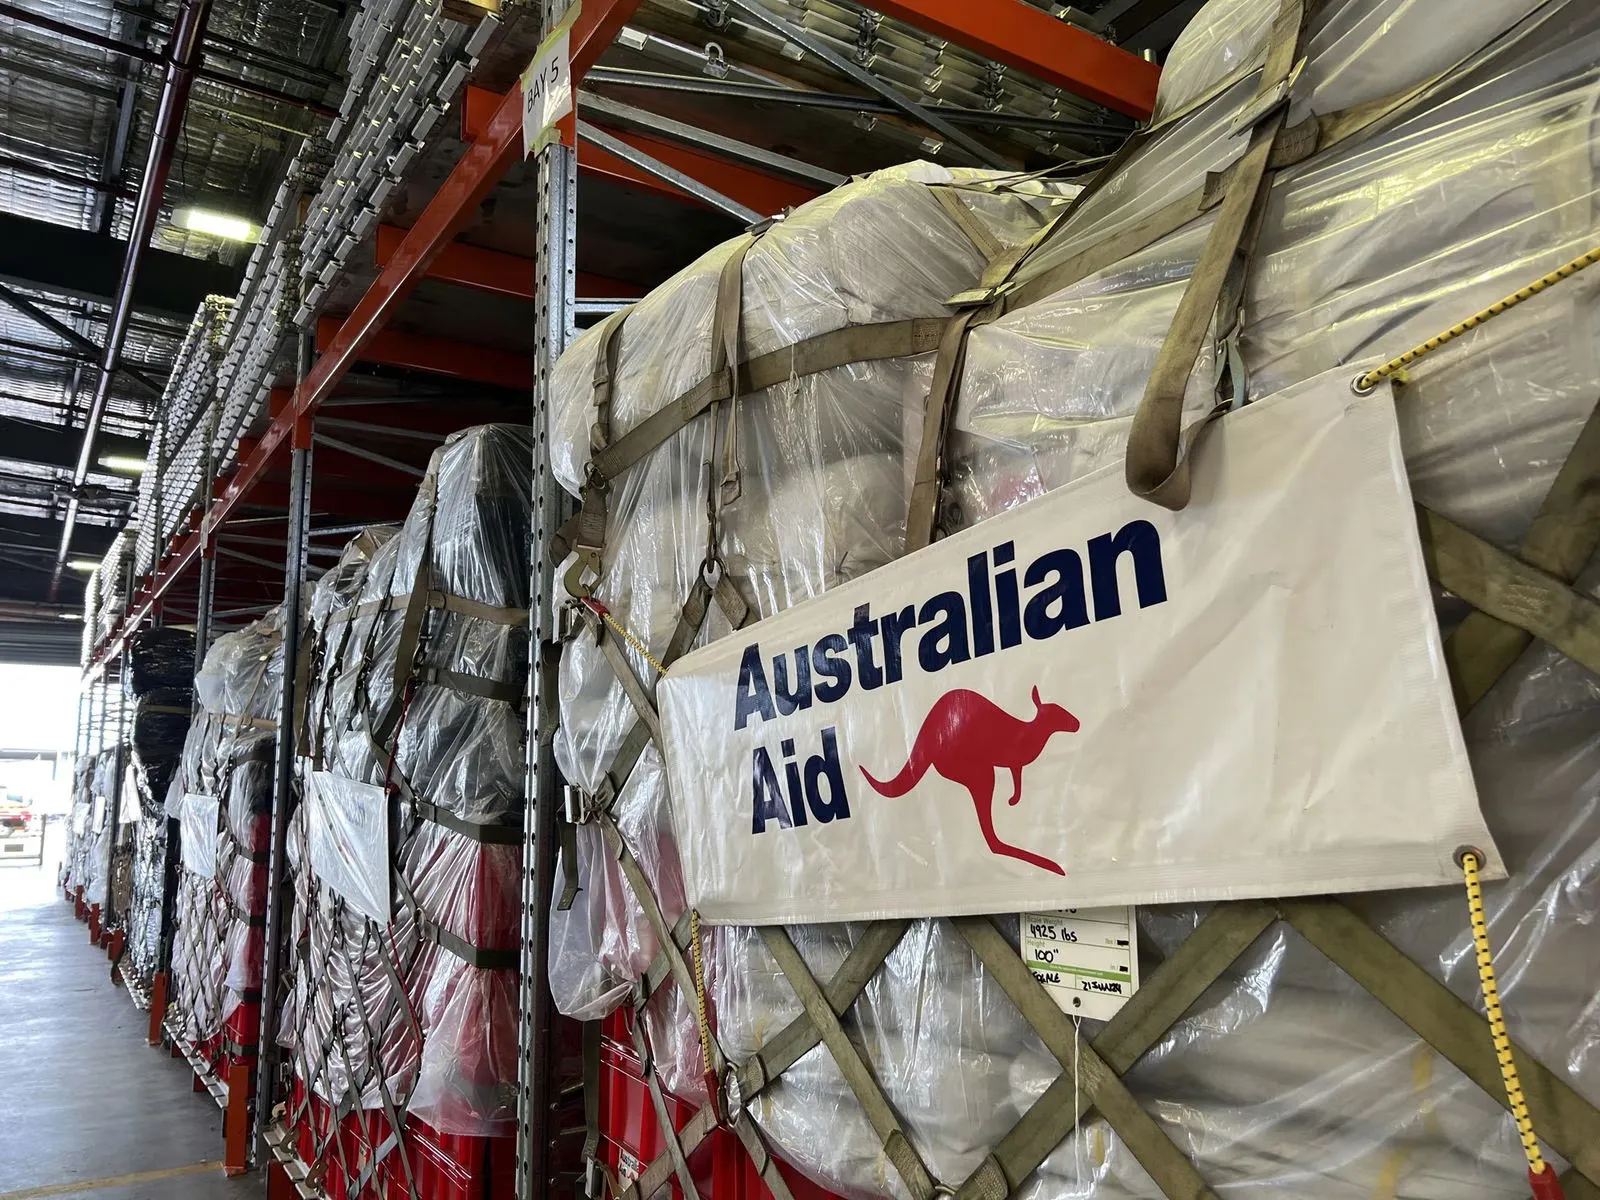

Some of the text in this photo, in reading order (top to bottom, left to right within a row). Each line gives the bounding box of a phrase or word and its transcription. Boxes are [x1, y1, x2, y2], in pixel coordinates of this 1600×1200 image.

[527, 56, 559, 114] BAY 5
[734, 519, 1167, 731] Australian
[752, 725, 851, 835] Aid
[1030, 924, 1056, 939] 4925
